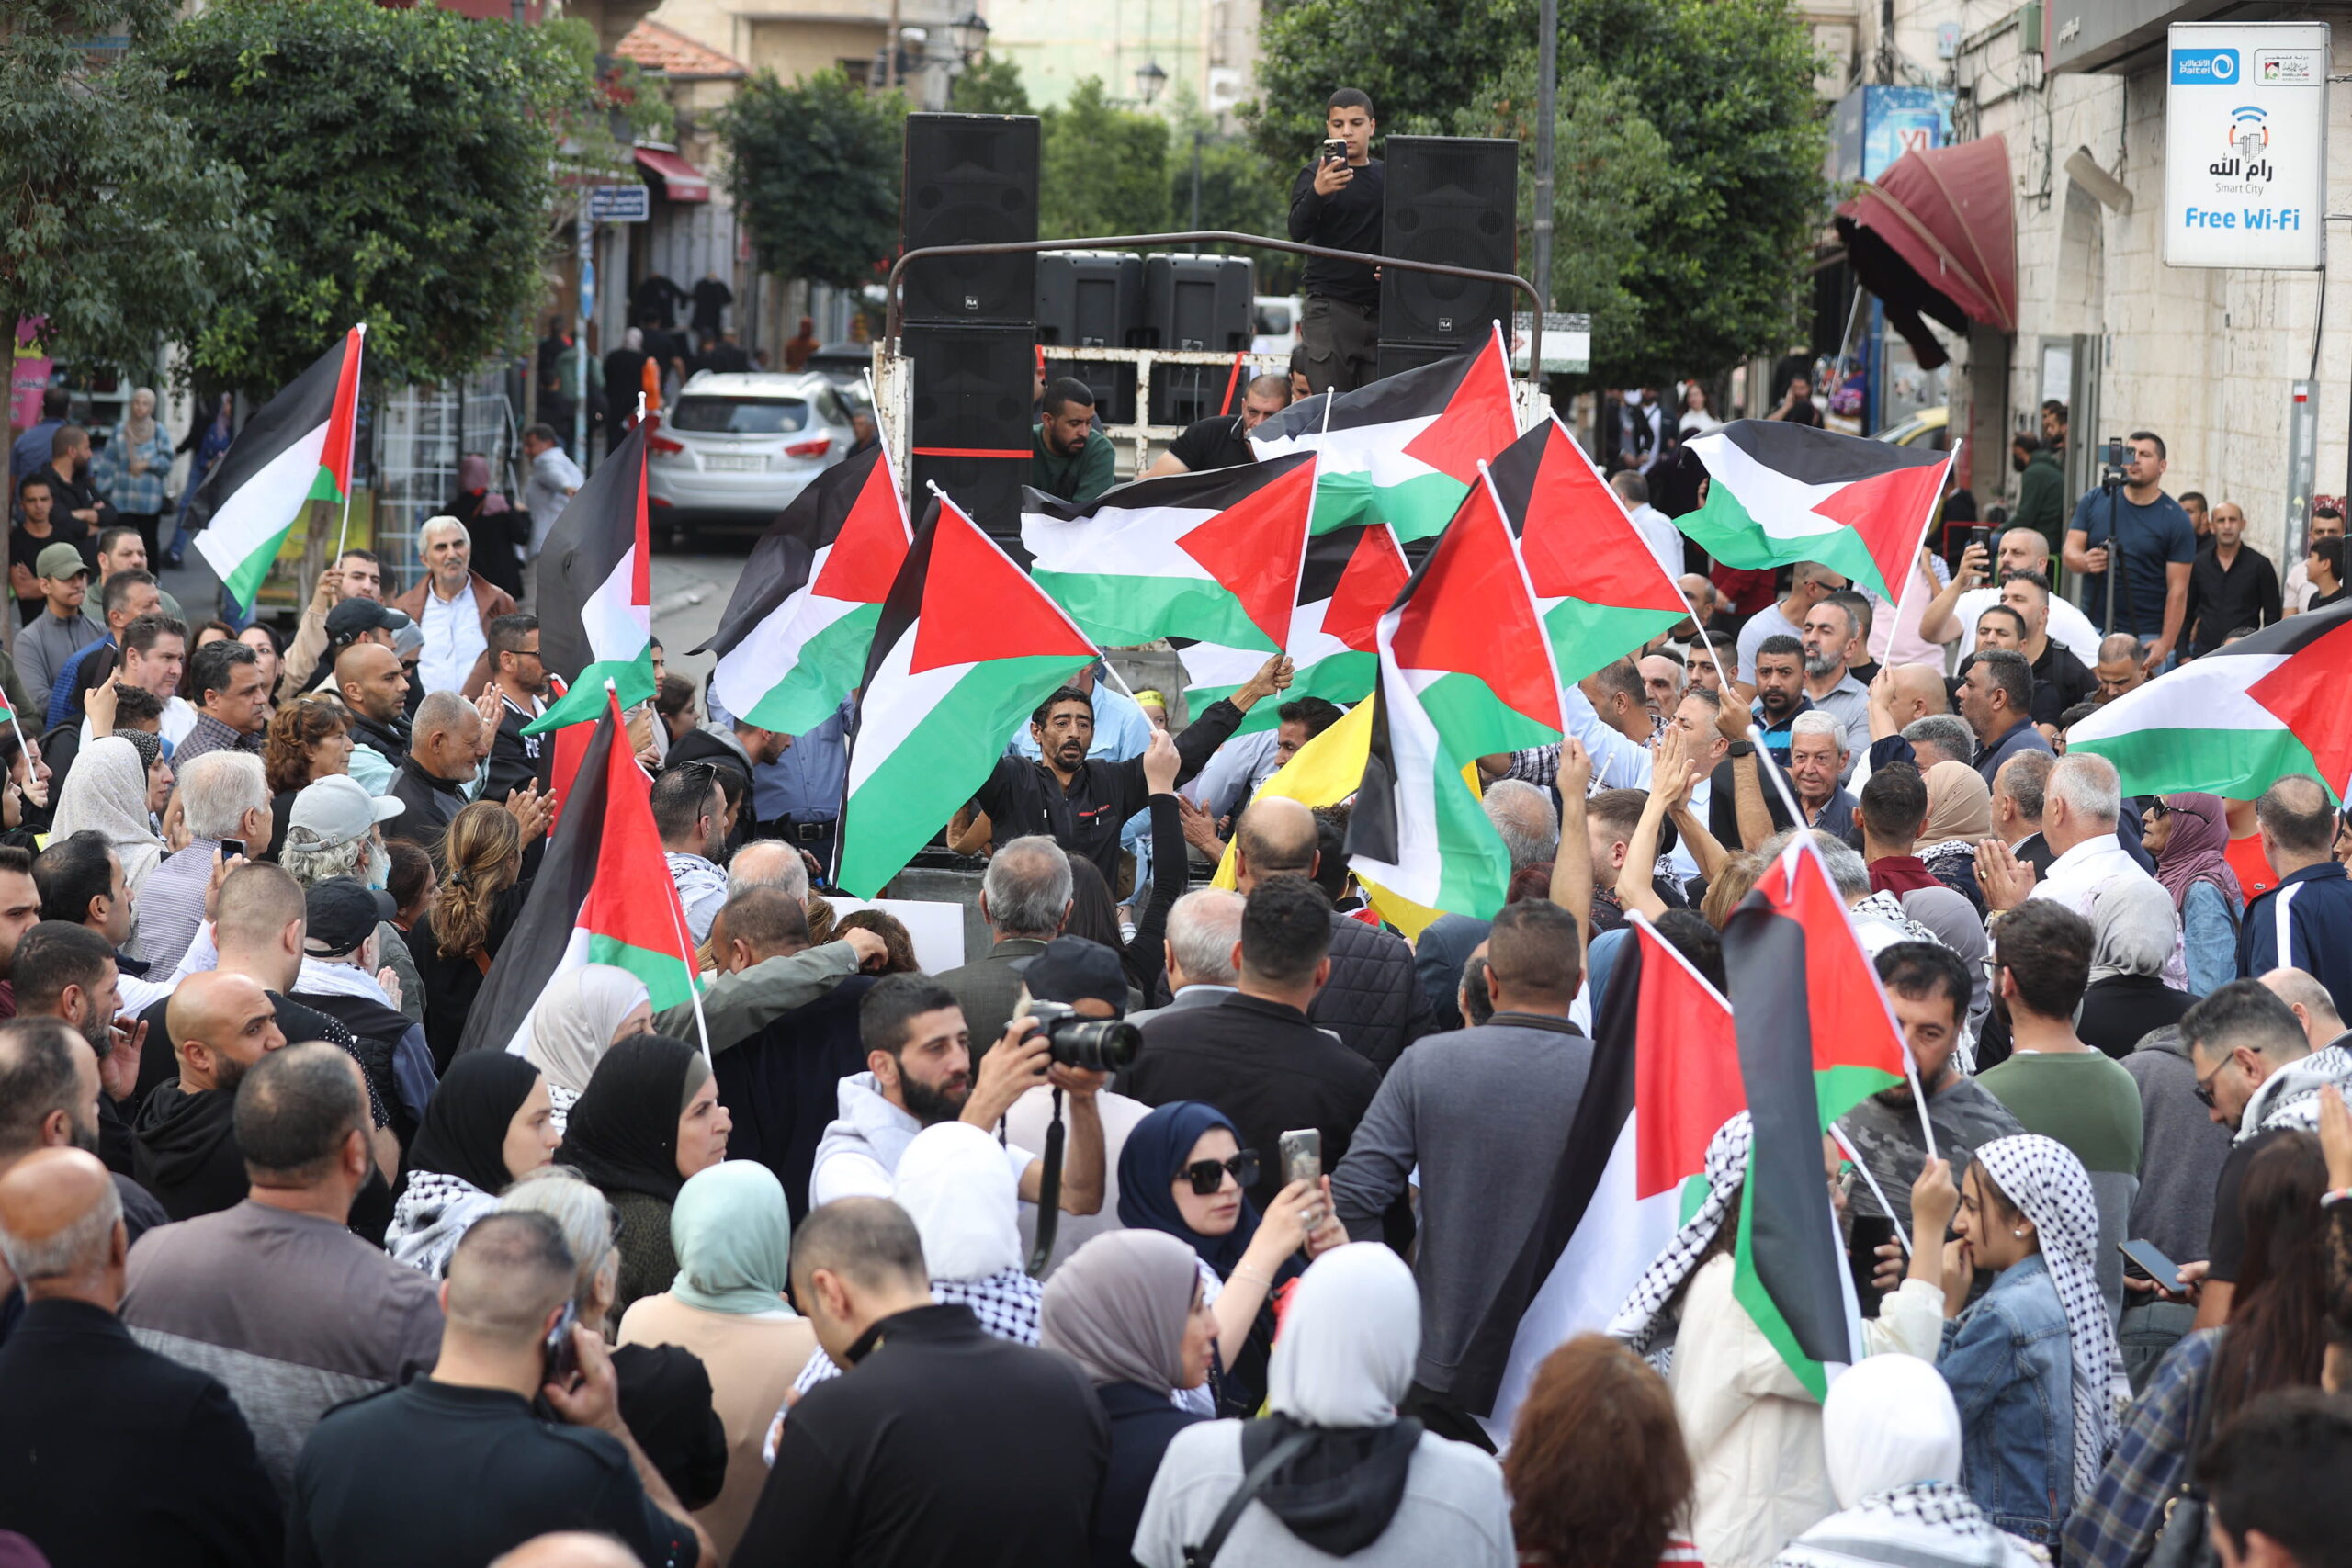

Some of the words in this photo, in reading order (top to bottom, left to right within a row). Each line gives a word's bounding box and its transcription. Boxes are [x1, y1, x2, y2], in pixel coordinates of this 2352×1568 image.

[2179, 66, 2211, 74] Paltel
[2209, 153, 2240, 176] الله
[2245, 159, 2273, 182] رام
[2215, 183, 2243, 193] Smart
[2245, 184, 2264, 197] City
[2186, 207, 2236, 229] Free
[2244, 208, 2300, 231] Wi-Fi
